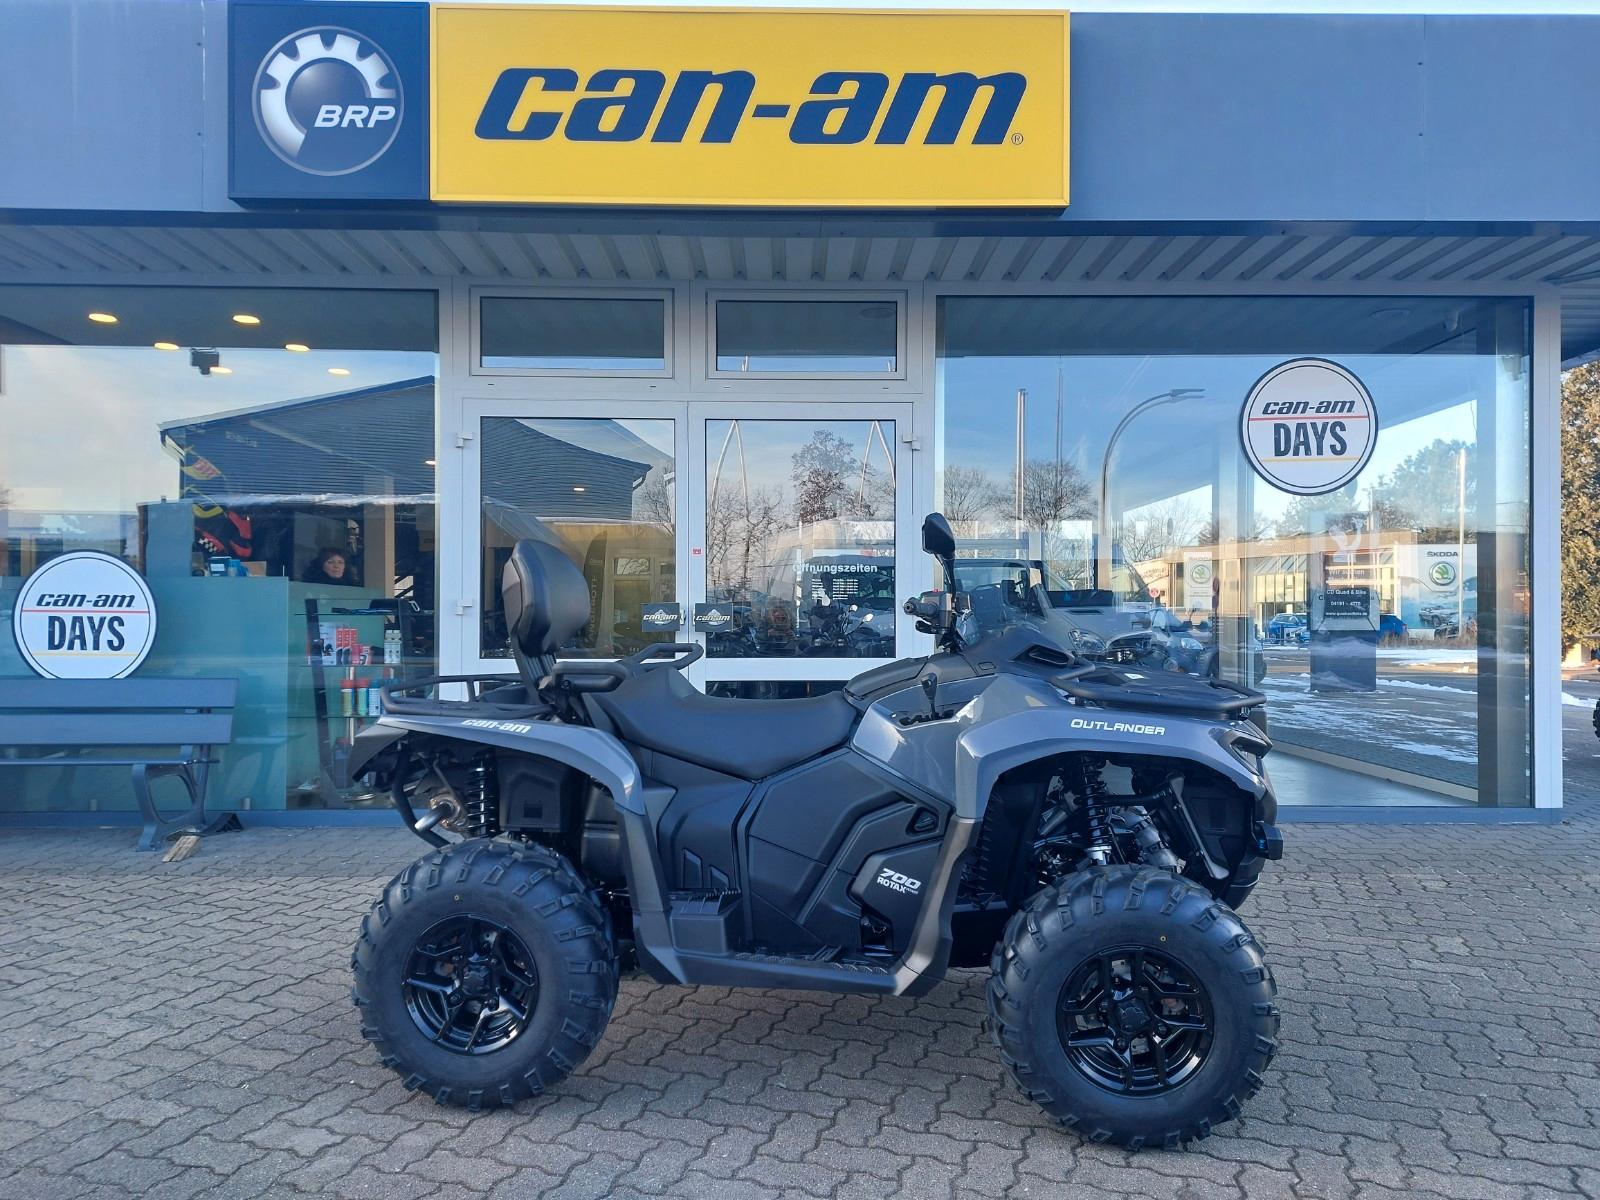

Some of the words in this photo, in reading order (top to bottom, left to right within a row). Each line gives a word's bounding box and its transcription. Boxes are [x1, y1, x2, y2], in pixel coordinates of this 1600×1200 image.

[314, 104, 396, 128] BRP
[474, 67, 1027, 145] can-am
[1262, 400, 1356, 415] can-am
[1273, 421, 1348, 457] DAYS
[36, 593, 136, 608] can-am
[47, 615, 125, 651] DAYS
[461, 719, 532, 734] can-am
[1070, 718, 1166, 736] OUTLANDER
[876, 876, 907, 894] ROTAX
[880, 867, 922, 890] 700
